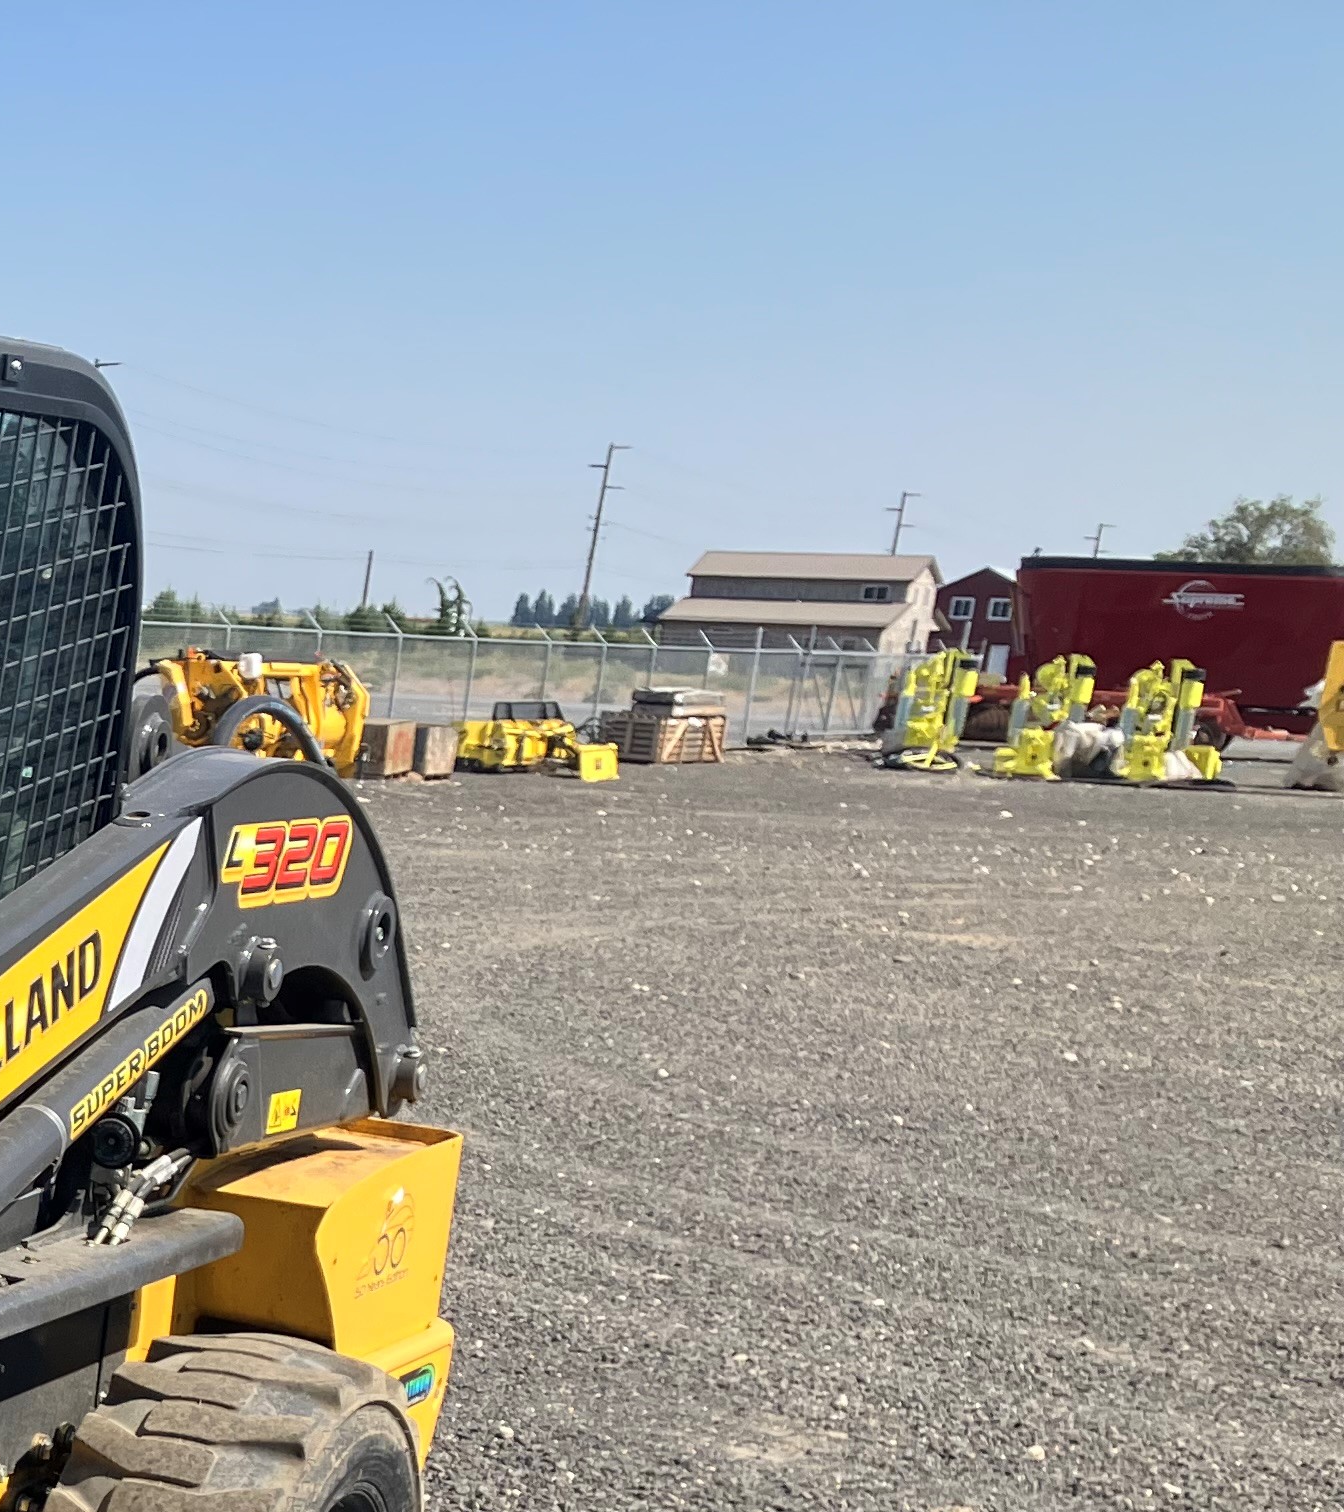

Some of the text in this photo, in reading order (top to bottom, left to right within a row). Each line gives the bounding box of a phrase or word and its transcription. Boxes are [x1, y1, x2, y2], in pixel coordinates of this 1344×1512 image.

[225, 820, 349, 895] L320
[73, 994, 204, 1133] SUPER BOOM
